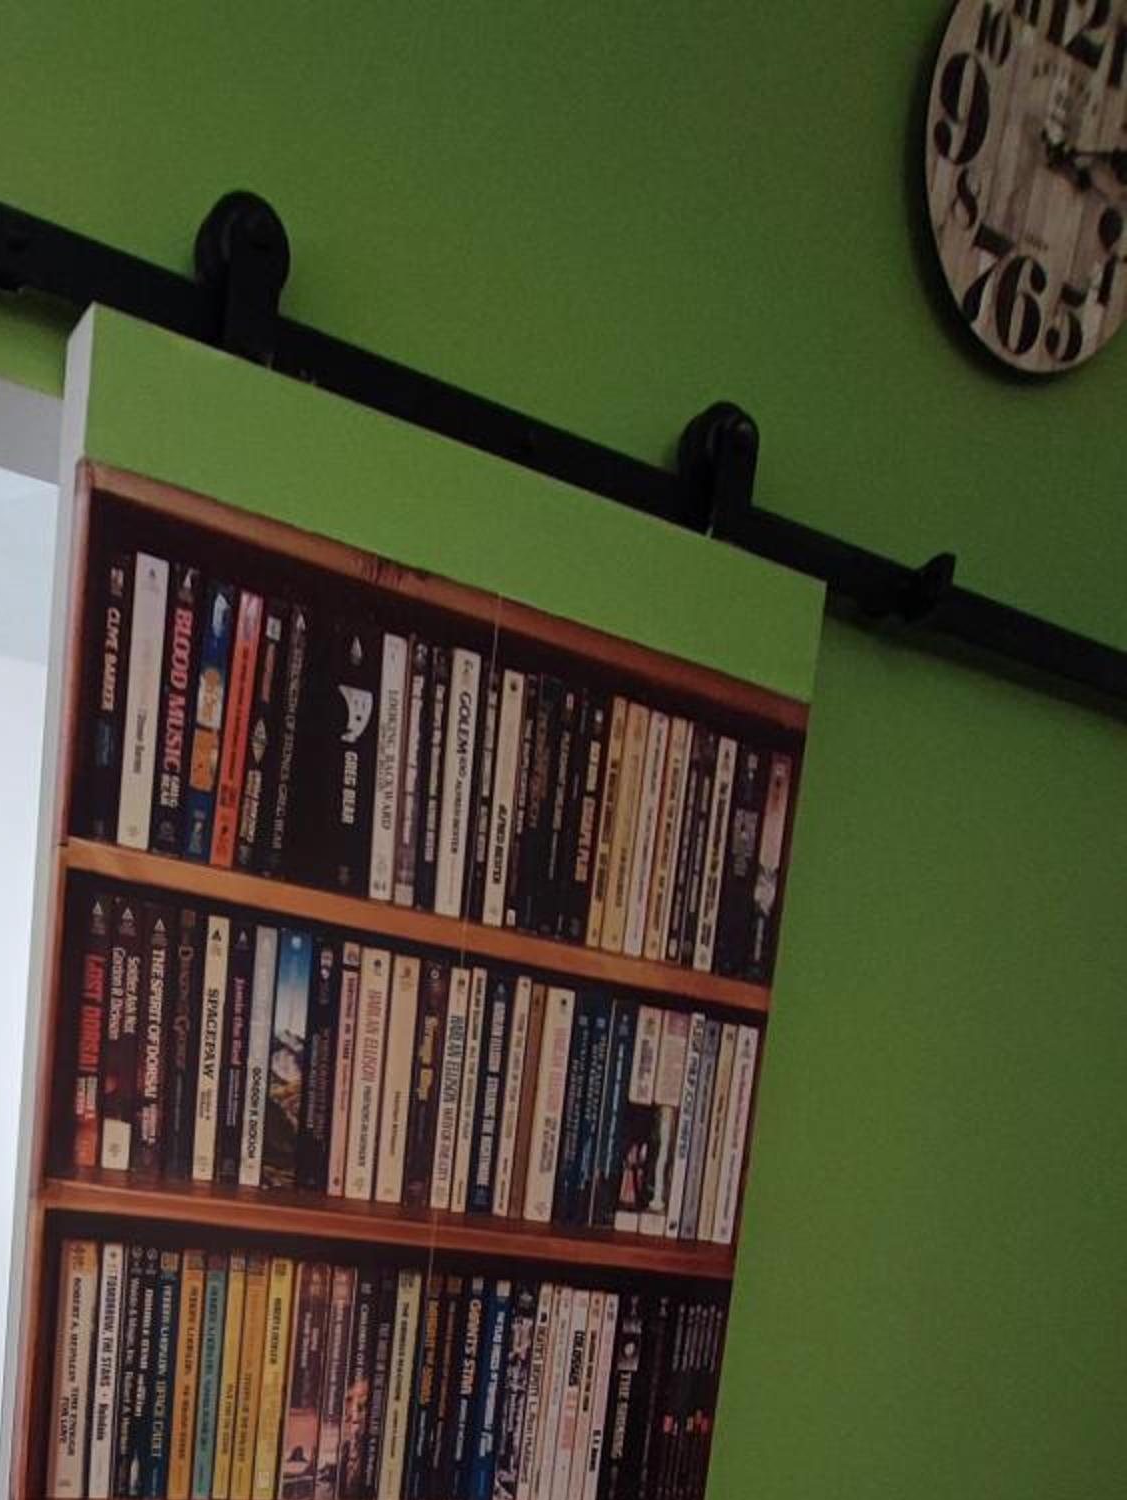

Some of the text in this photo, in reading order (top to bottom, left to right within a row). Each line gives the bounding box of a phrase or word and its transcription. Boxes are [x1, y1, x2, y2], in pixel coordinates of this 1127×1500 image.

[935, 52, 990, 164] 9
[996, 256, 1046, 355] 6
[1046, 283, 1087, 361] 5
[98, 605, 121, 712] CLIVE BARKER
[162, 606, 192, 772] BLOOD MUSIC
[454, 690, 474, 756] GOLEM
[342, 749, 359, 787] GREG
[378, 687, 401, 831] LOOKING BACKWARD
[339, 787, 356, 825] BEAR
[122, 1017, 135, 1034] Not
[123, 992, 137, 1014] Ask
[142, 948, 165, 1098] THE SPIRIT OF DORSAI
[364, 989, 382, 1035] HARLAN
[201, 987, 220, 1079] SPACEPAW
[361, 1036, 378, 1083] ELLISON
[446, 1014, 465, 1060] HARLAN
[441, 1059, 460, 1104] ELLISON
[99, 1357, 112, 1387] STARS
